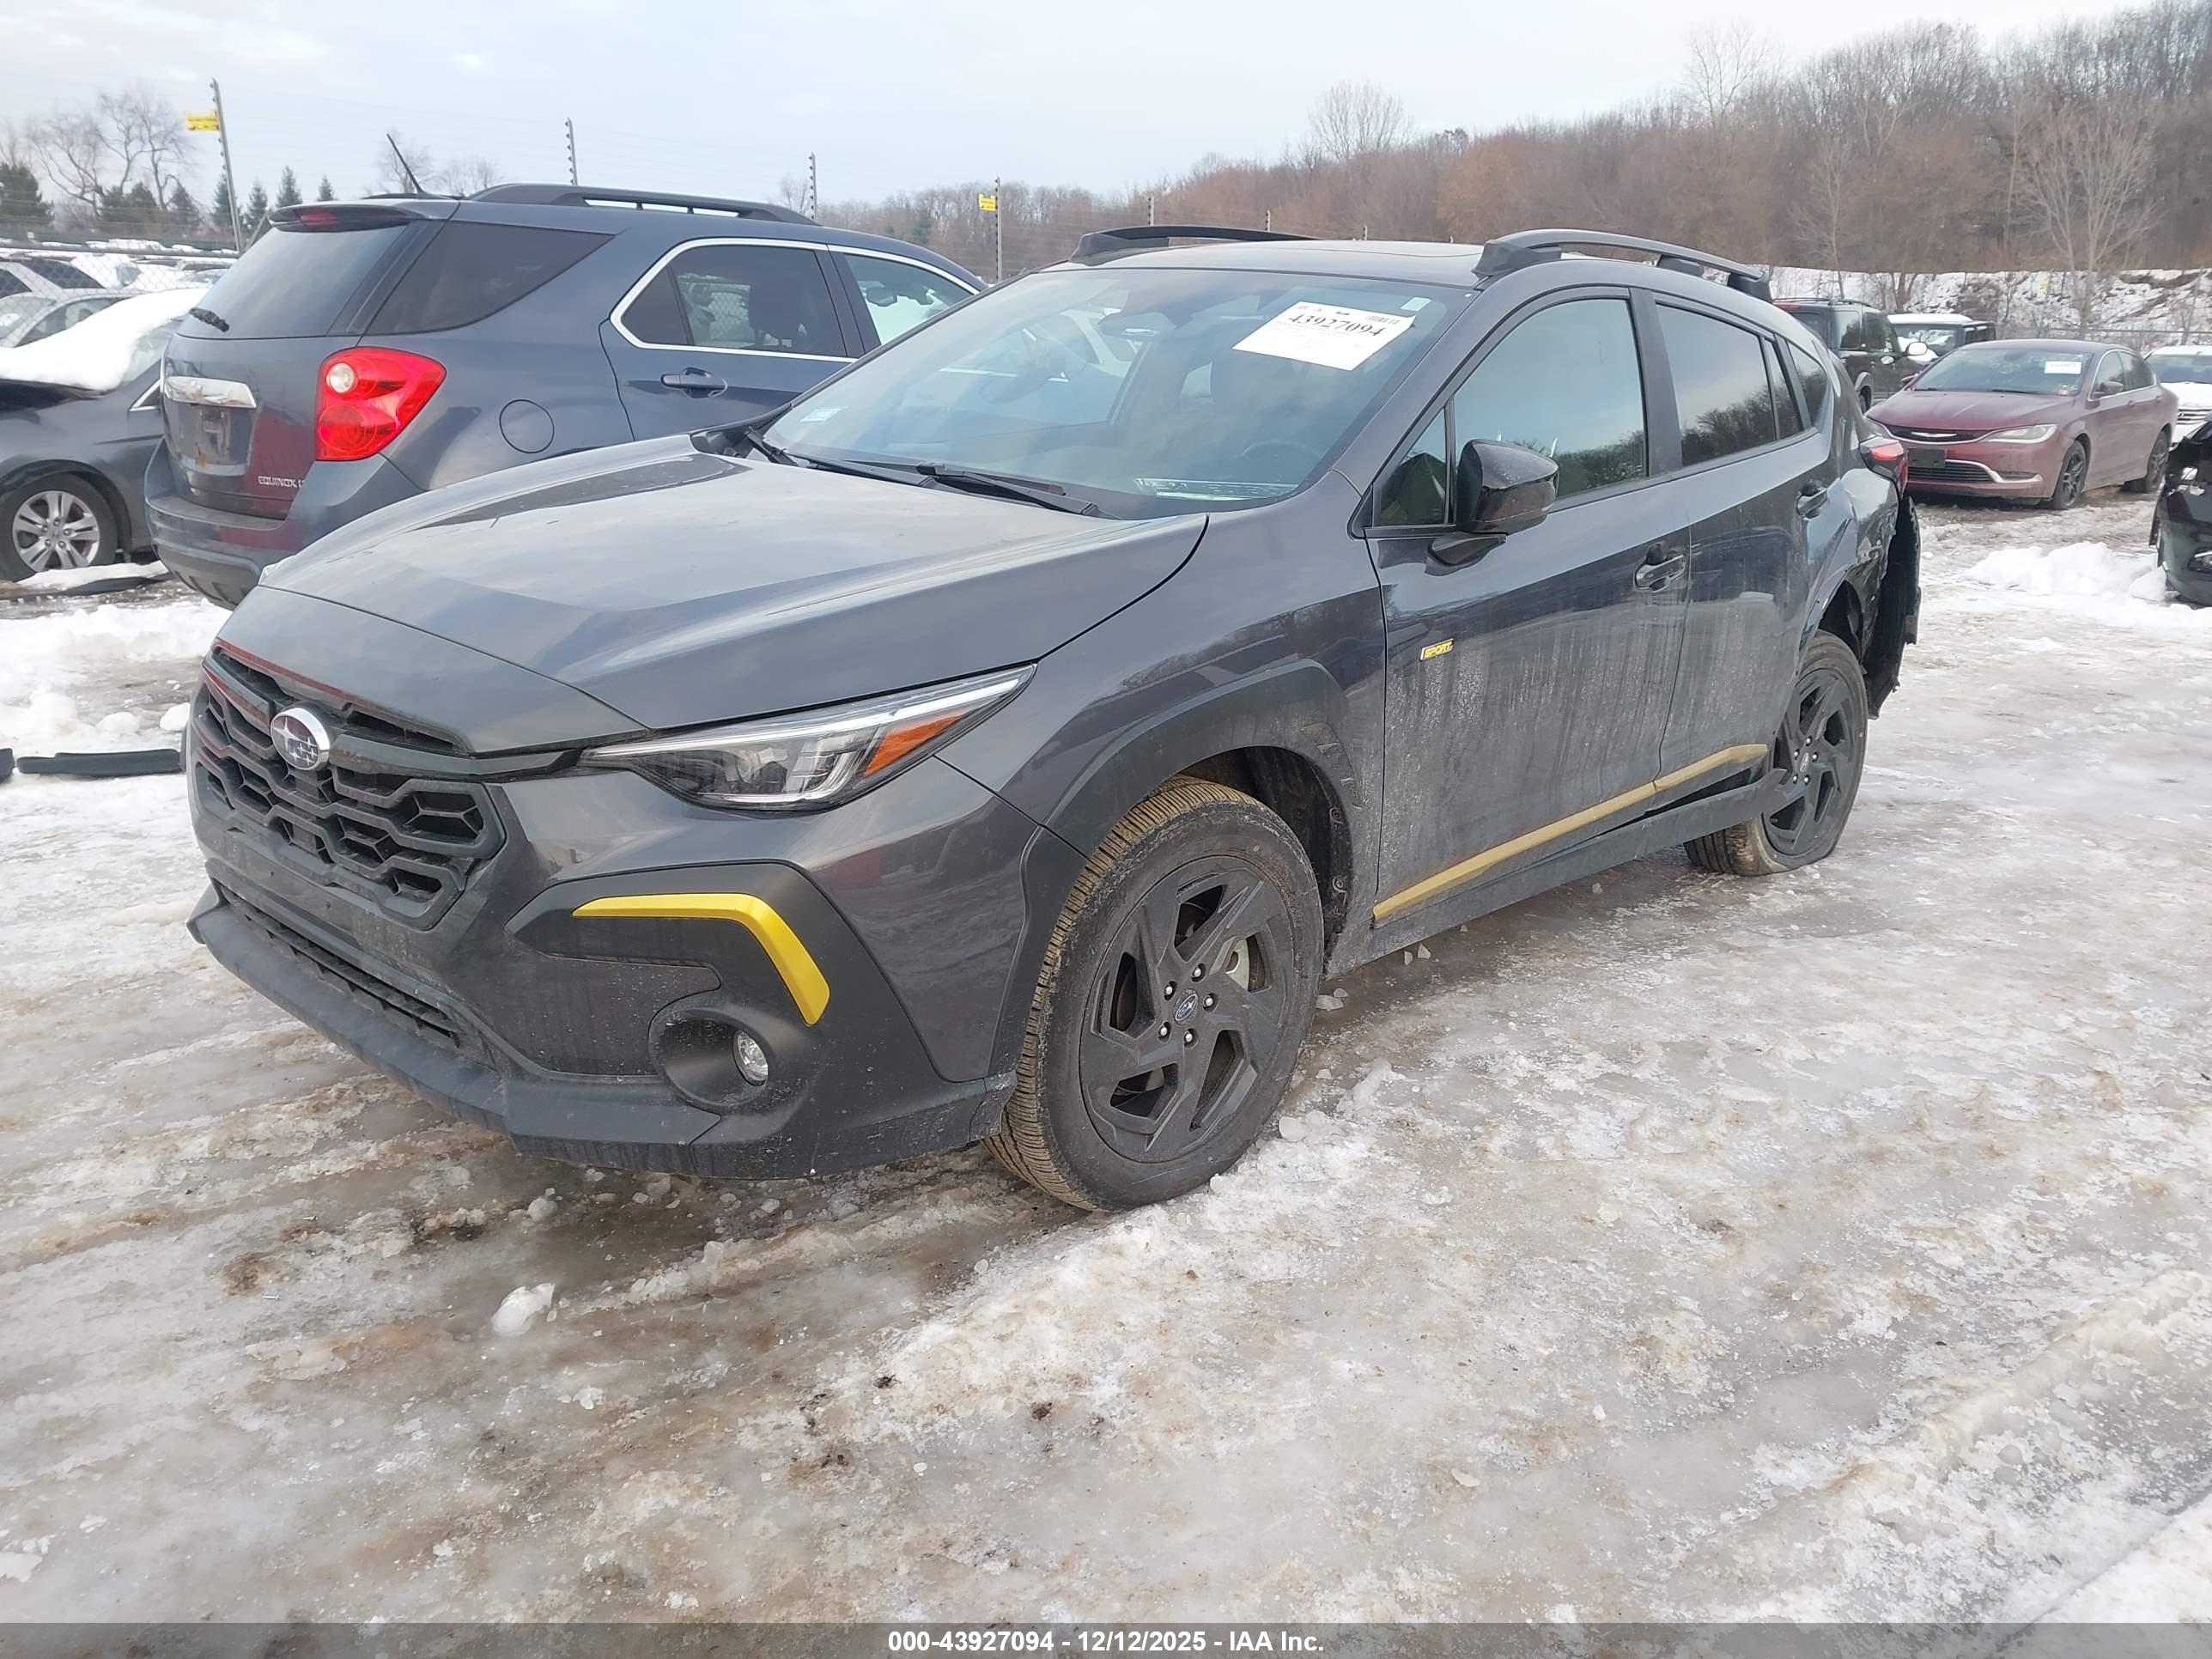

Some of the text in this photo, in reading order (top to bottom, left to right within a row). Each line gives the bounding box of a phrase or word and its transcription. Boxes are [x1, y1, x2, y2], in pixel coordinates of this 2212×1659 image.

[1289, 313, 1386, 337] 43927094
[258, 476, 297, 488] EQUINOX
[1424, 641, 1453, 659] SPORT
